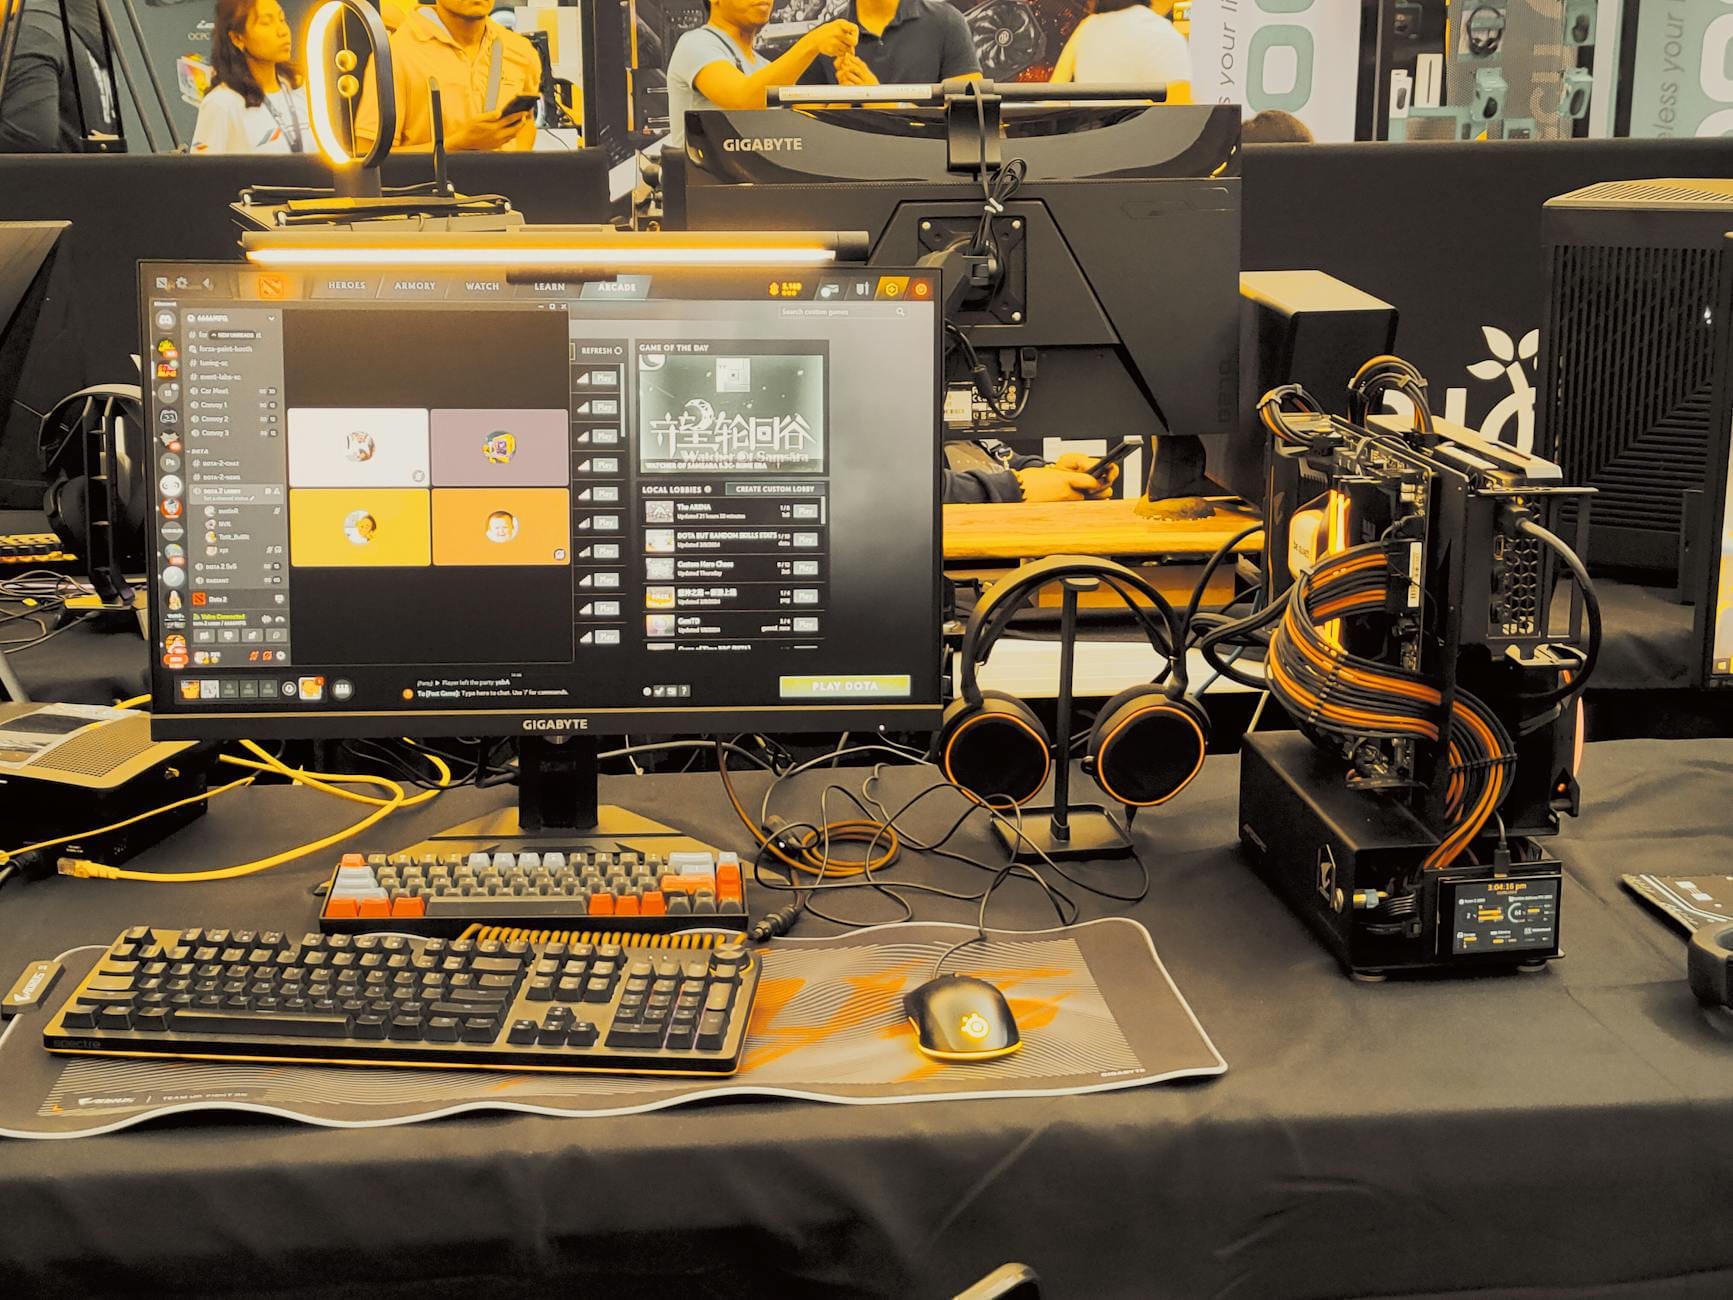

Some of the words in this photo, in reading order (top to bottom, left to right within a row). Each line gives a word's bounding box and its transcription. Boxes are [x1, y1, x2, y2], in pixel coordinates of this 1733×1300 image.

[1662, 11, 1686, 73] your
[1219, 21, 1237, 86] your
[723, 137, 803, 152] GIGABYTE
[328, 281, 366, 290] HEROES
[394, 281, 436, 291] ARMORY
[465, 282, 500, 291] WATCH
[534, 282, 566, 291] LEARN
[597, 283, 637, 292] ARCADE
[581, 347, 613, 355] REFRESH
[639, 344, 661, 352] GAME
[663, 344, 674, 352] OF
[676, 344, 692, 352] THE
[693, 344, 710, 352] DAY
[642, 486, 668, 494] LOCAL
[669, 486, 702, 494] LOBBIES
[792, 485, 815, 493] LOBBY
[812, 681, 841, 691] PLAY
[845, 681, 879, 691] DOTA
[522, 718, 588, 730] GIGABYTE
